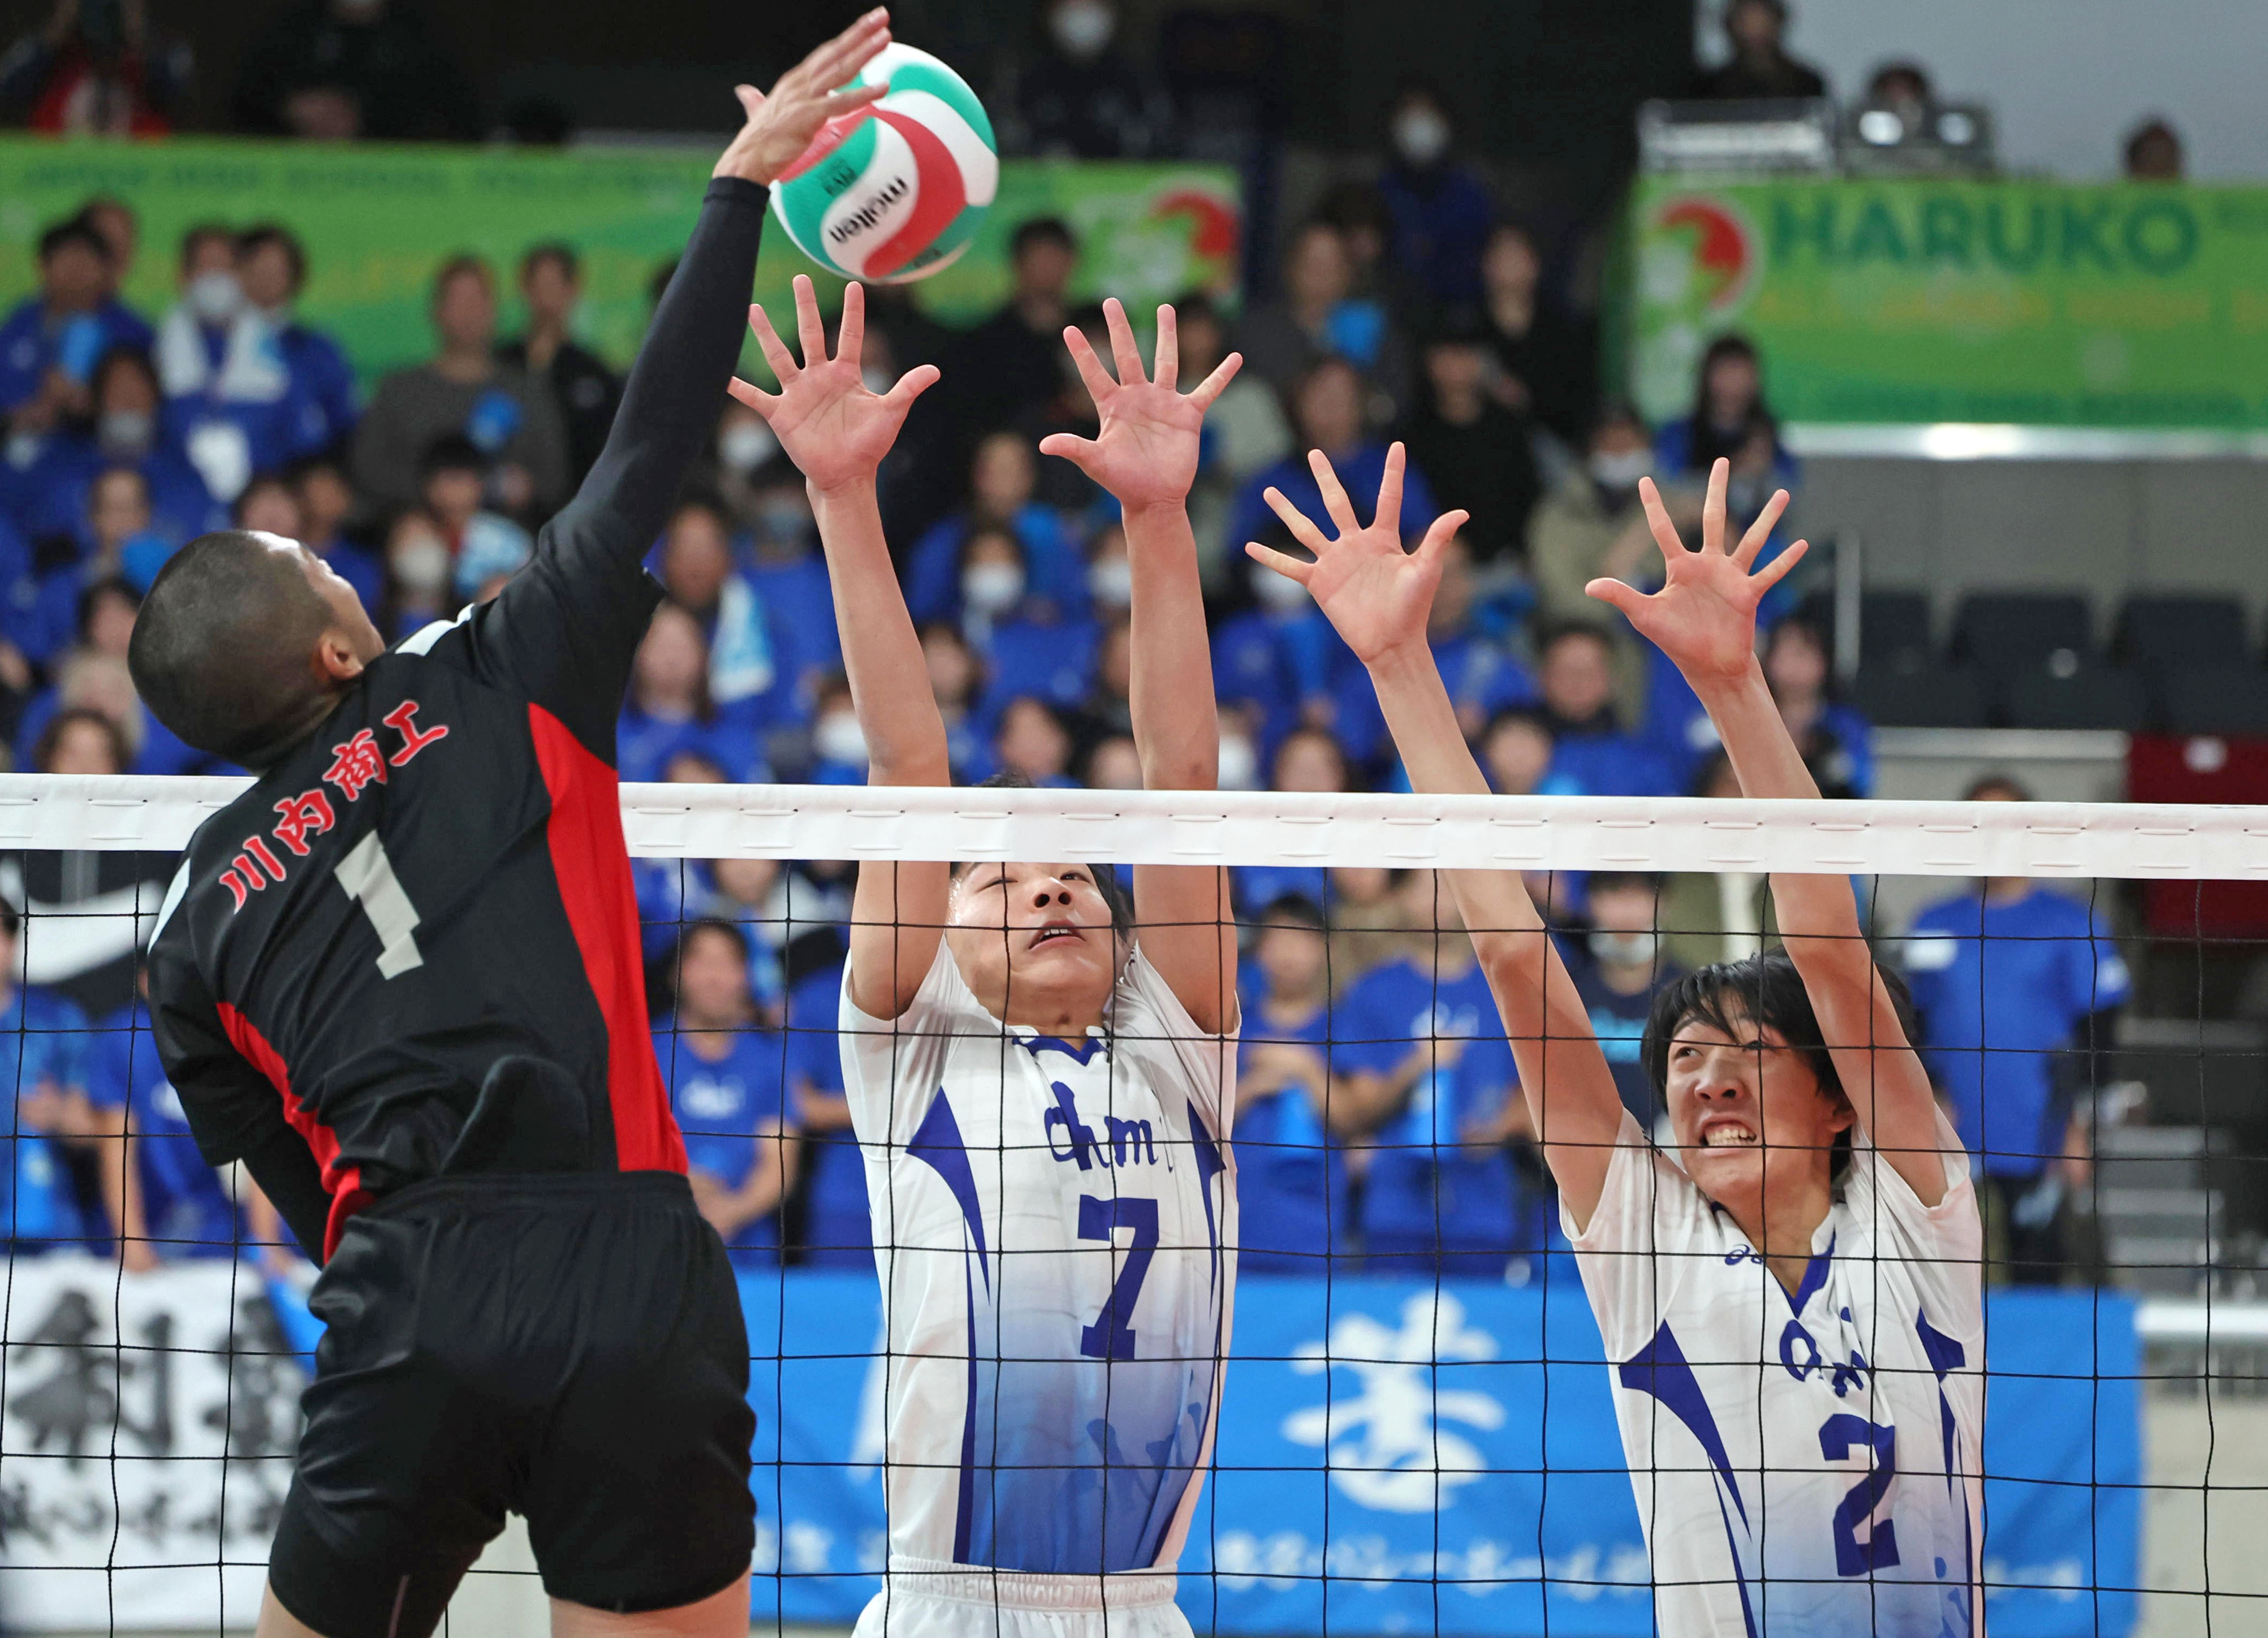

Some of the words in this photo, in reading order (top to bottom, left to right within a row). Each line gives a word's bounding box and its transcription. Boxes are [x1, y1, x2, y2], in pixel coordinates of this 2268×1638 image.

[829, 177, 908, 243] molten
[1771, 195, 2199, 277] HARUKO
[218, 699, 449, 915] 川内商工
[333, 828, 424, 981] 1
[1077, 1194, 1159, 1360] 7
[1818, 1413, 1901, 1577] 2
